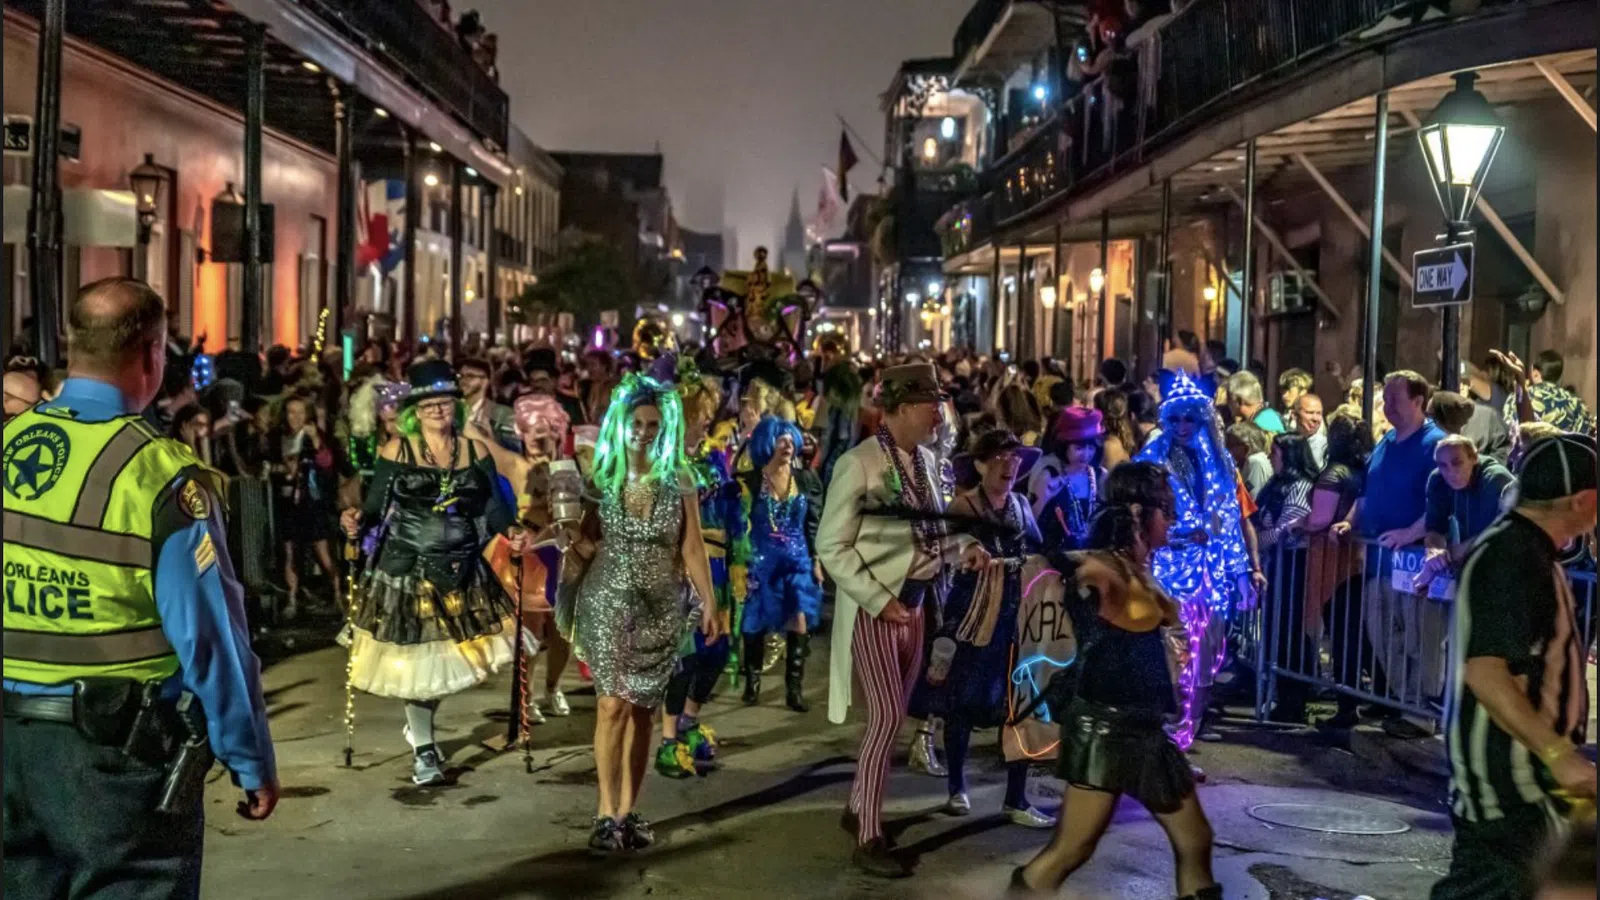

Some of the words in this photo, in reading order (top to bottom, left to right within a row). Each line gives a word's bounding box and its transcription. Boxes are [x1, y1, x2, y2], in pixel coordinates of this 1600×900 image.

[1418, 268, 1434, 289] ONE
[1436, 266, 1453, 287] WAY
[15, 429, 61, 447] ORLEANS
[51, 441, 66, 482] POLICE
[4, 561, 90, 587] ORLEANS
[3, 580, 95, 620] LICE
